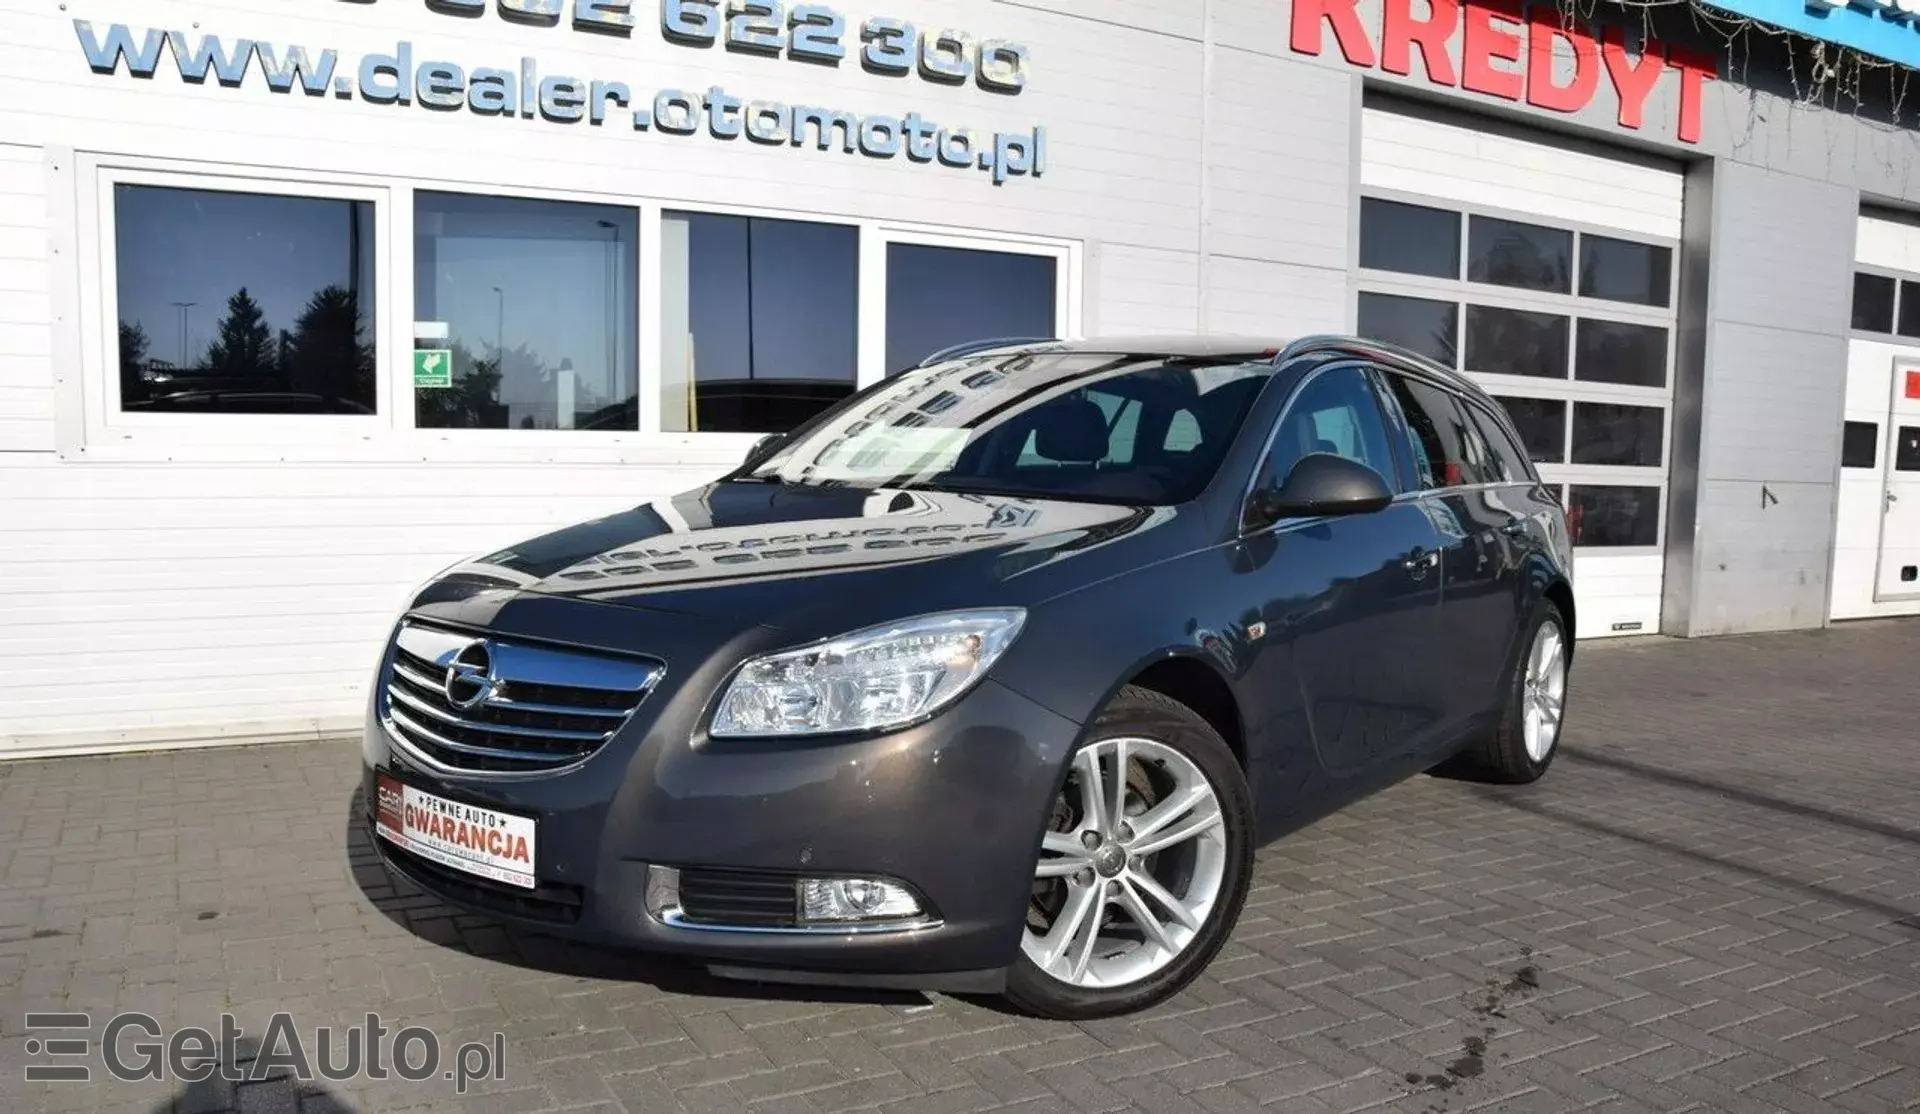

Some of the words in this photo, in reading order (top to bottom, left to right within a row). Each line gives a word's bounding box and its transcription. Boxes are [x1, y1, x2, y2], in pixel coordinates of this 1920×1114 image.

[660, 0, 846, 68] 622
[859, 16, 1031, 96] 300
[1289, 0, 1719, 144] KREDYT
[72, 18, 1047, 186] www.dealer.otomoto.pl
[404, 803, 531, 864] GWARANCJA
[426, 797, 461, 818] PEWNE
[465, 809, 496, 827] AUTO
